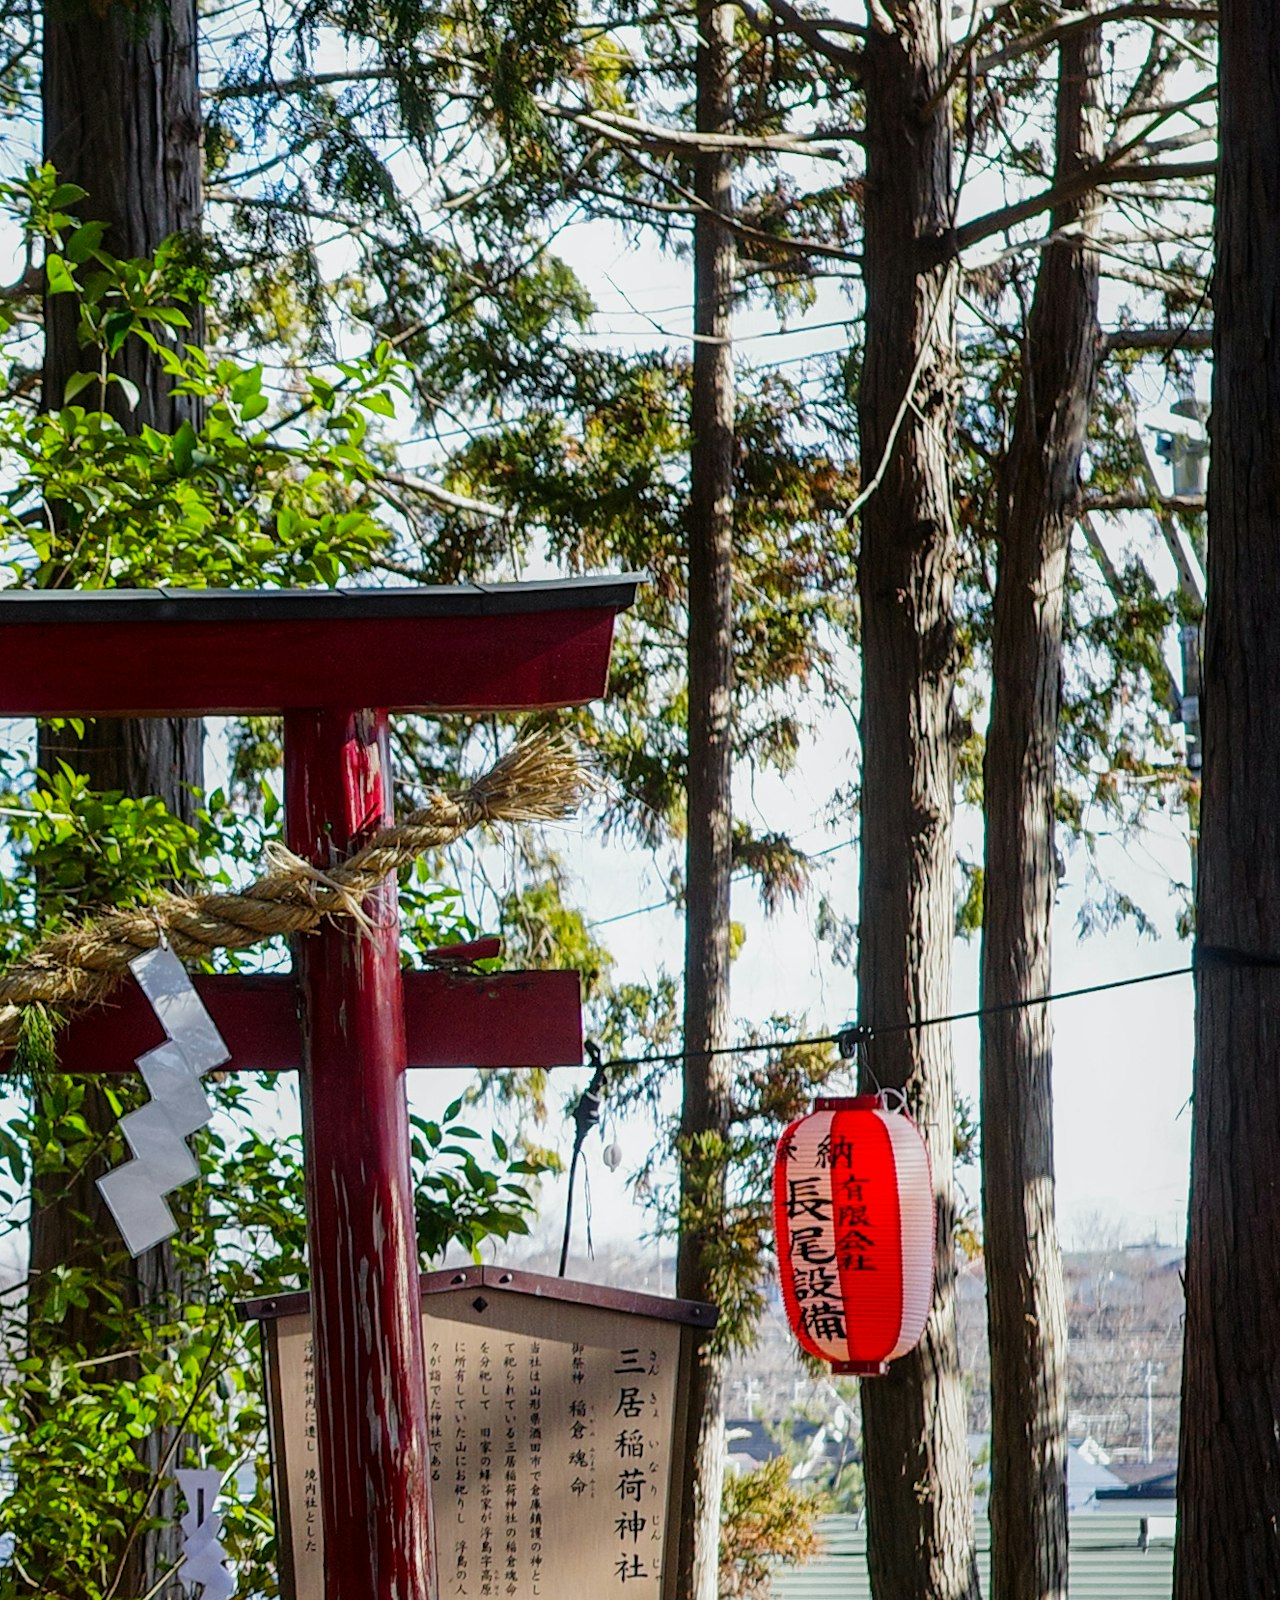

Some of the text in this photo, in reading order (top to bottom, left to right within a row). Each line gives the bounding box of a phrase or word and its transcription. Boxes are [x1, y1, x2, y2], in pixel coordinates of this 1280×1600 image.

[784, 1177, 846, 1341] 長尾設備
[836, 1176, 877, 1270] 有限会社
[480, 1343, 492, 1410] を分祀して
[572, 1343, 584, 1384] 御祭神
[304, 1468, 317, 1553] 境内社とした
[455, 1343, 468, 1596] に所有していた山にお祀りし 浮島の人
[504, 1342, 518, 1596] て祀られている三居稲荷神社の稲倉魂命
[529, 1342, 542, 1596] 当社は山形県酒田市で倉庫鎮護の神とし
[614, 1349, 648, 1583] 三居稲荷神社
